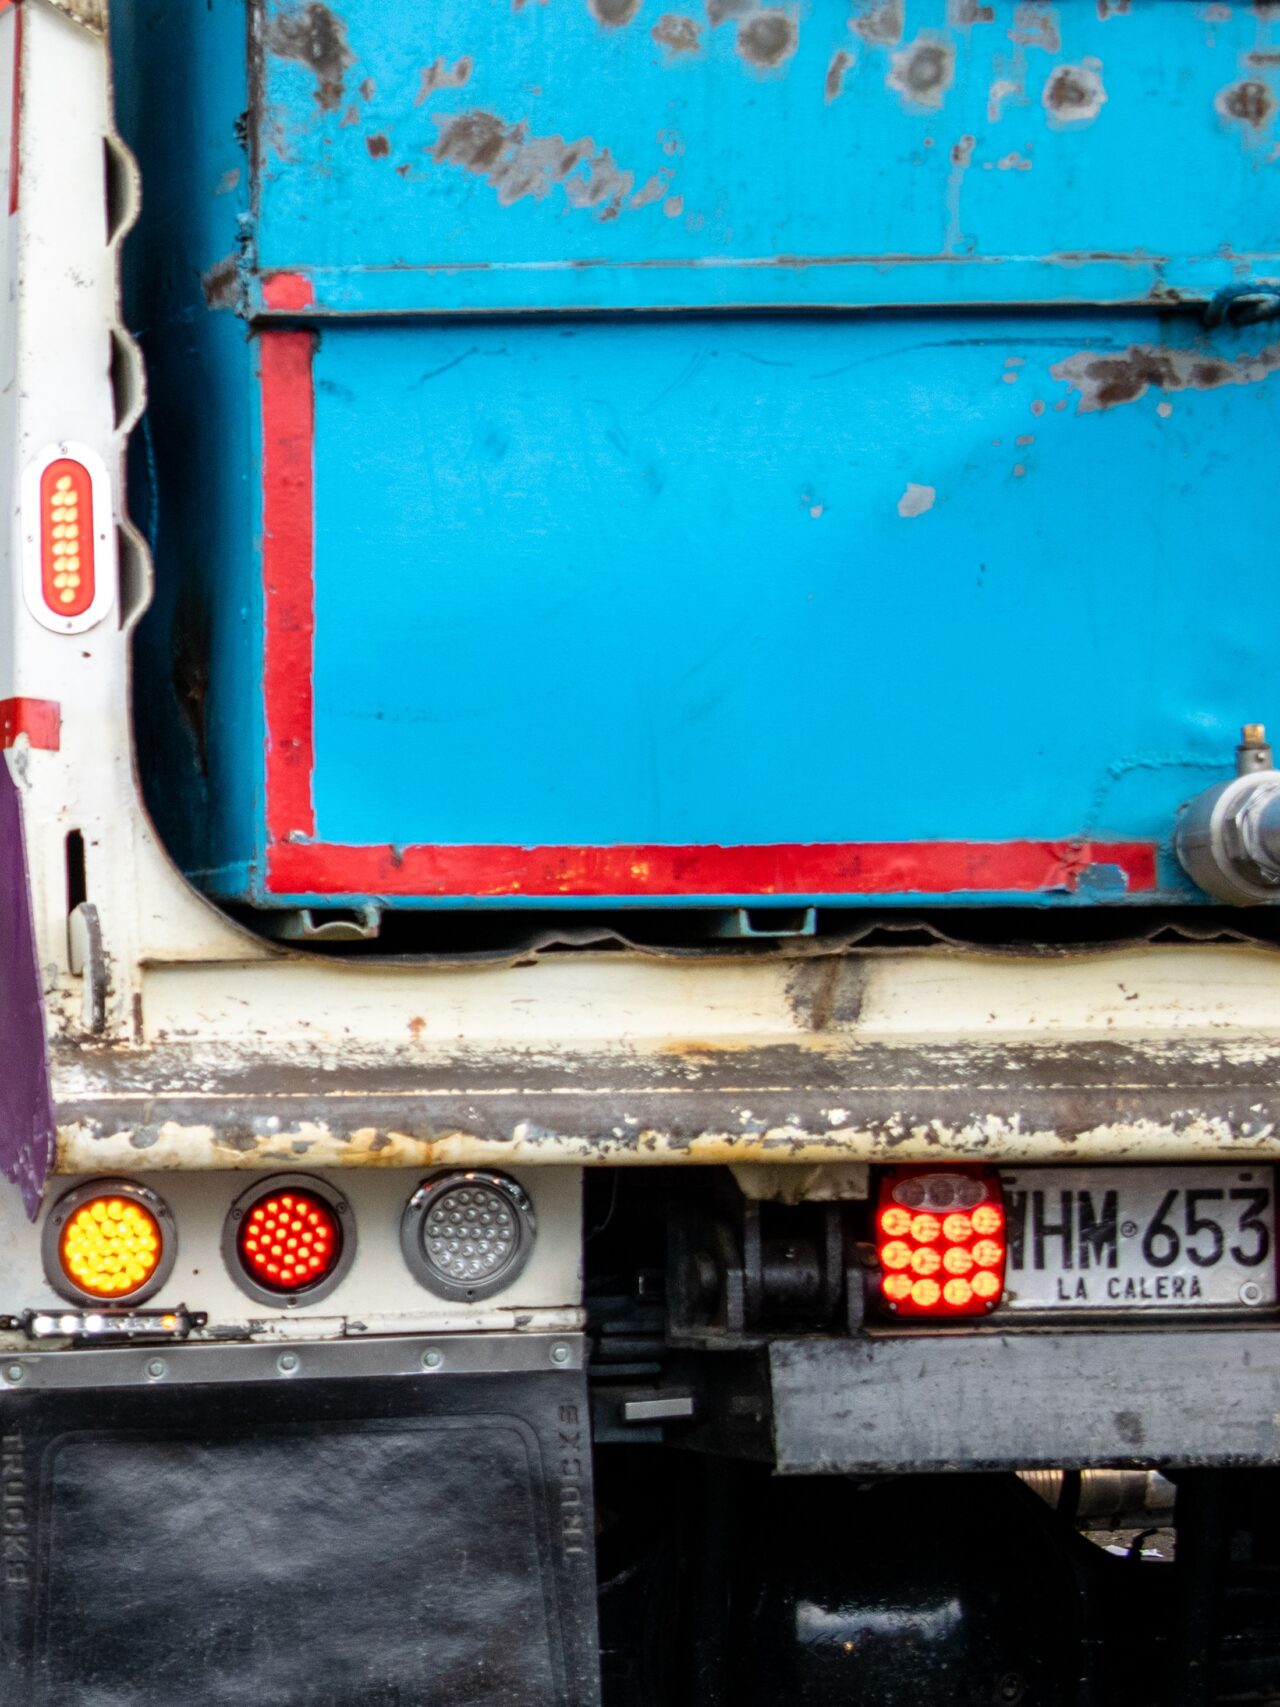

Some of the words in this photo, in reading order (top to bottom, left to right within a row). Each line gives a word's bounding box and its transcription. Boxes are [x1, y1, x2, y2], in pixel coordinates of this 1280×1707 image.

[1142, 1188, 1269, 1268] 653
[1057, 1277, 1087, 1300] LA
[1107, 1275, 1203, 1299] CALERA
